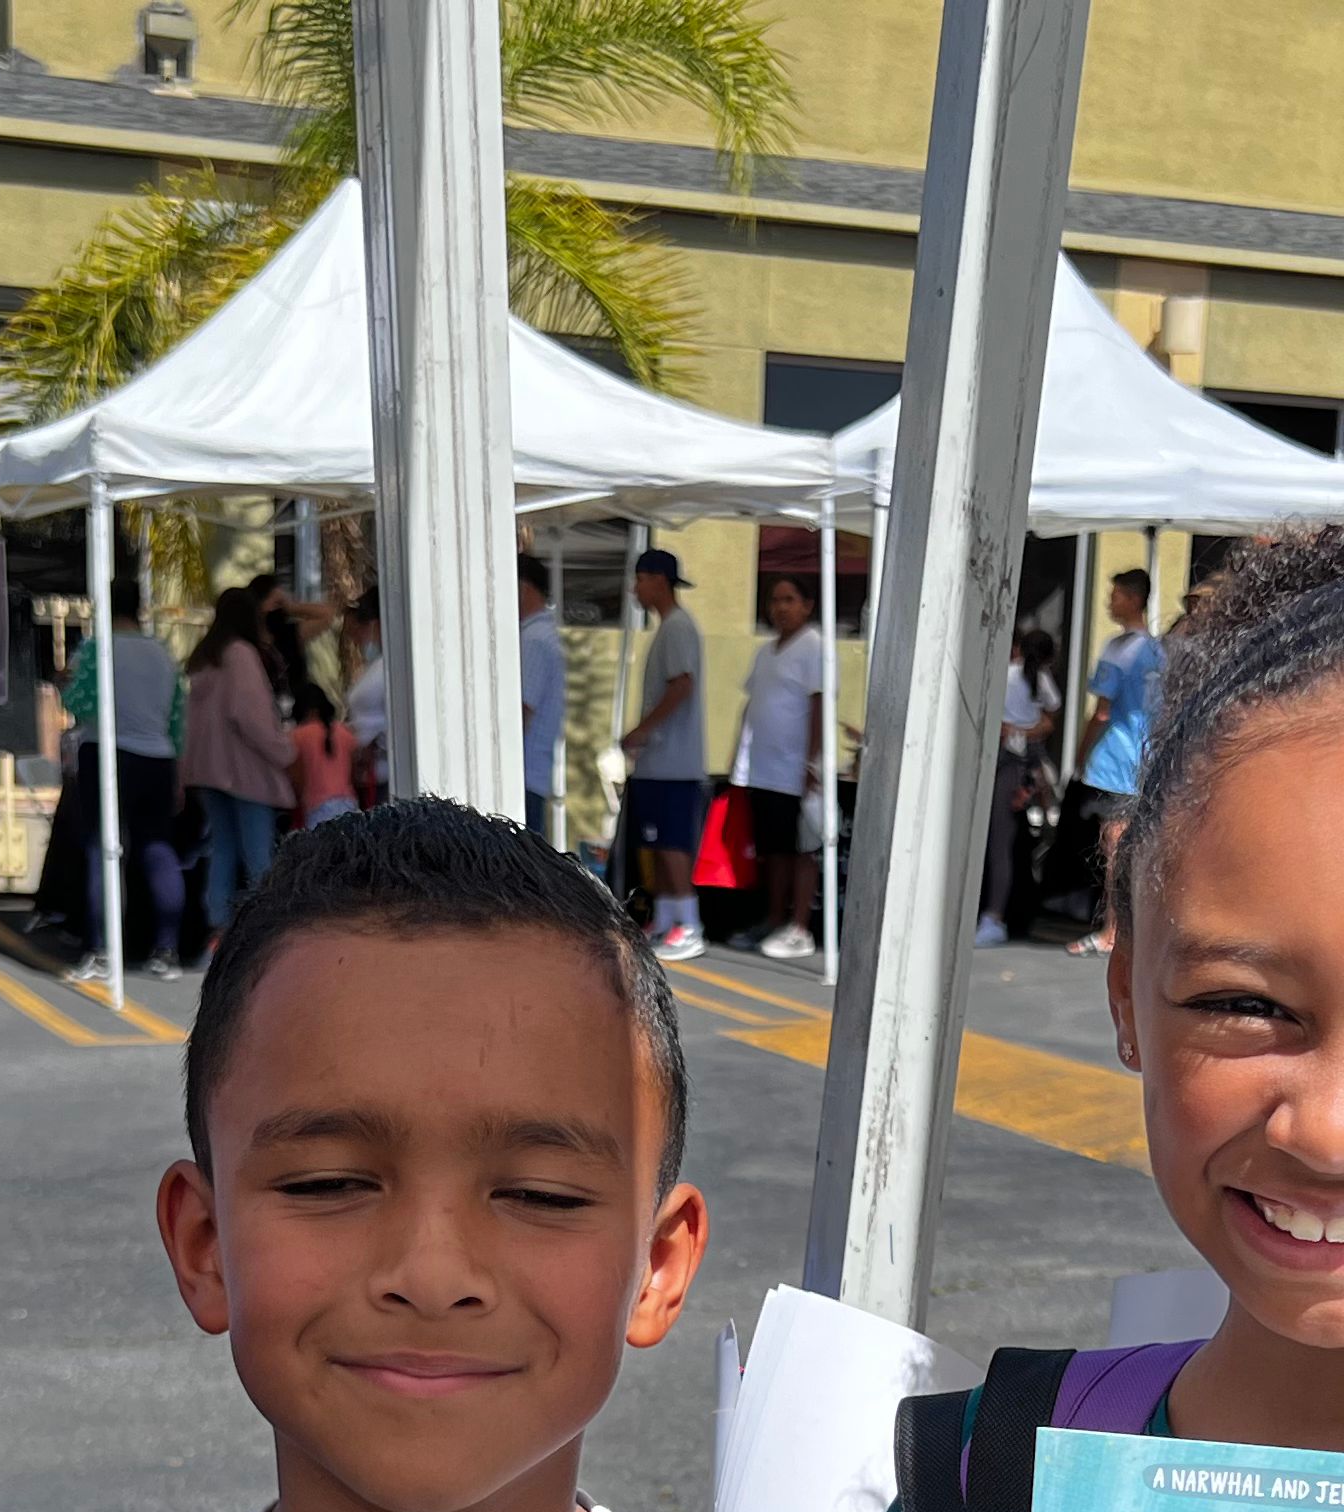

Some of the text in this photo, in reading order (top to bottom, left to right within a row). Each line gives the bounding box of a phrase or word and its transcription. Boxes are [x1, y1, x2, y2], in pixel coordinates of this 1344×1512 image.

[1153, 1467, 1165, 1489] A
[1171, 1469, 1265, 1498] NARWHAL
[1271, 1477, 1310, 1500] AND
